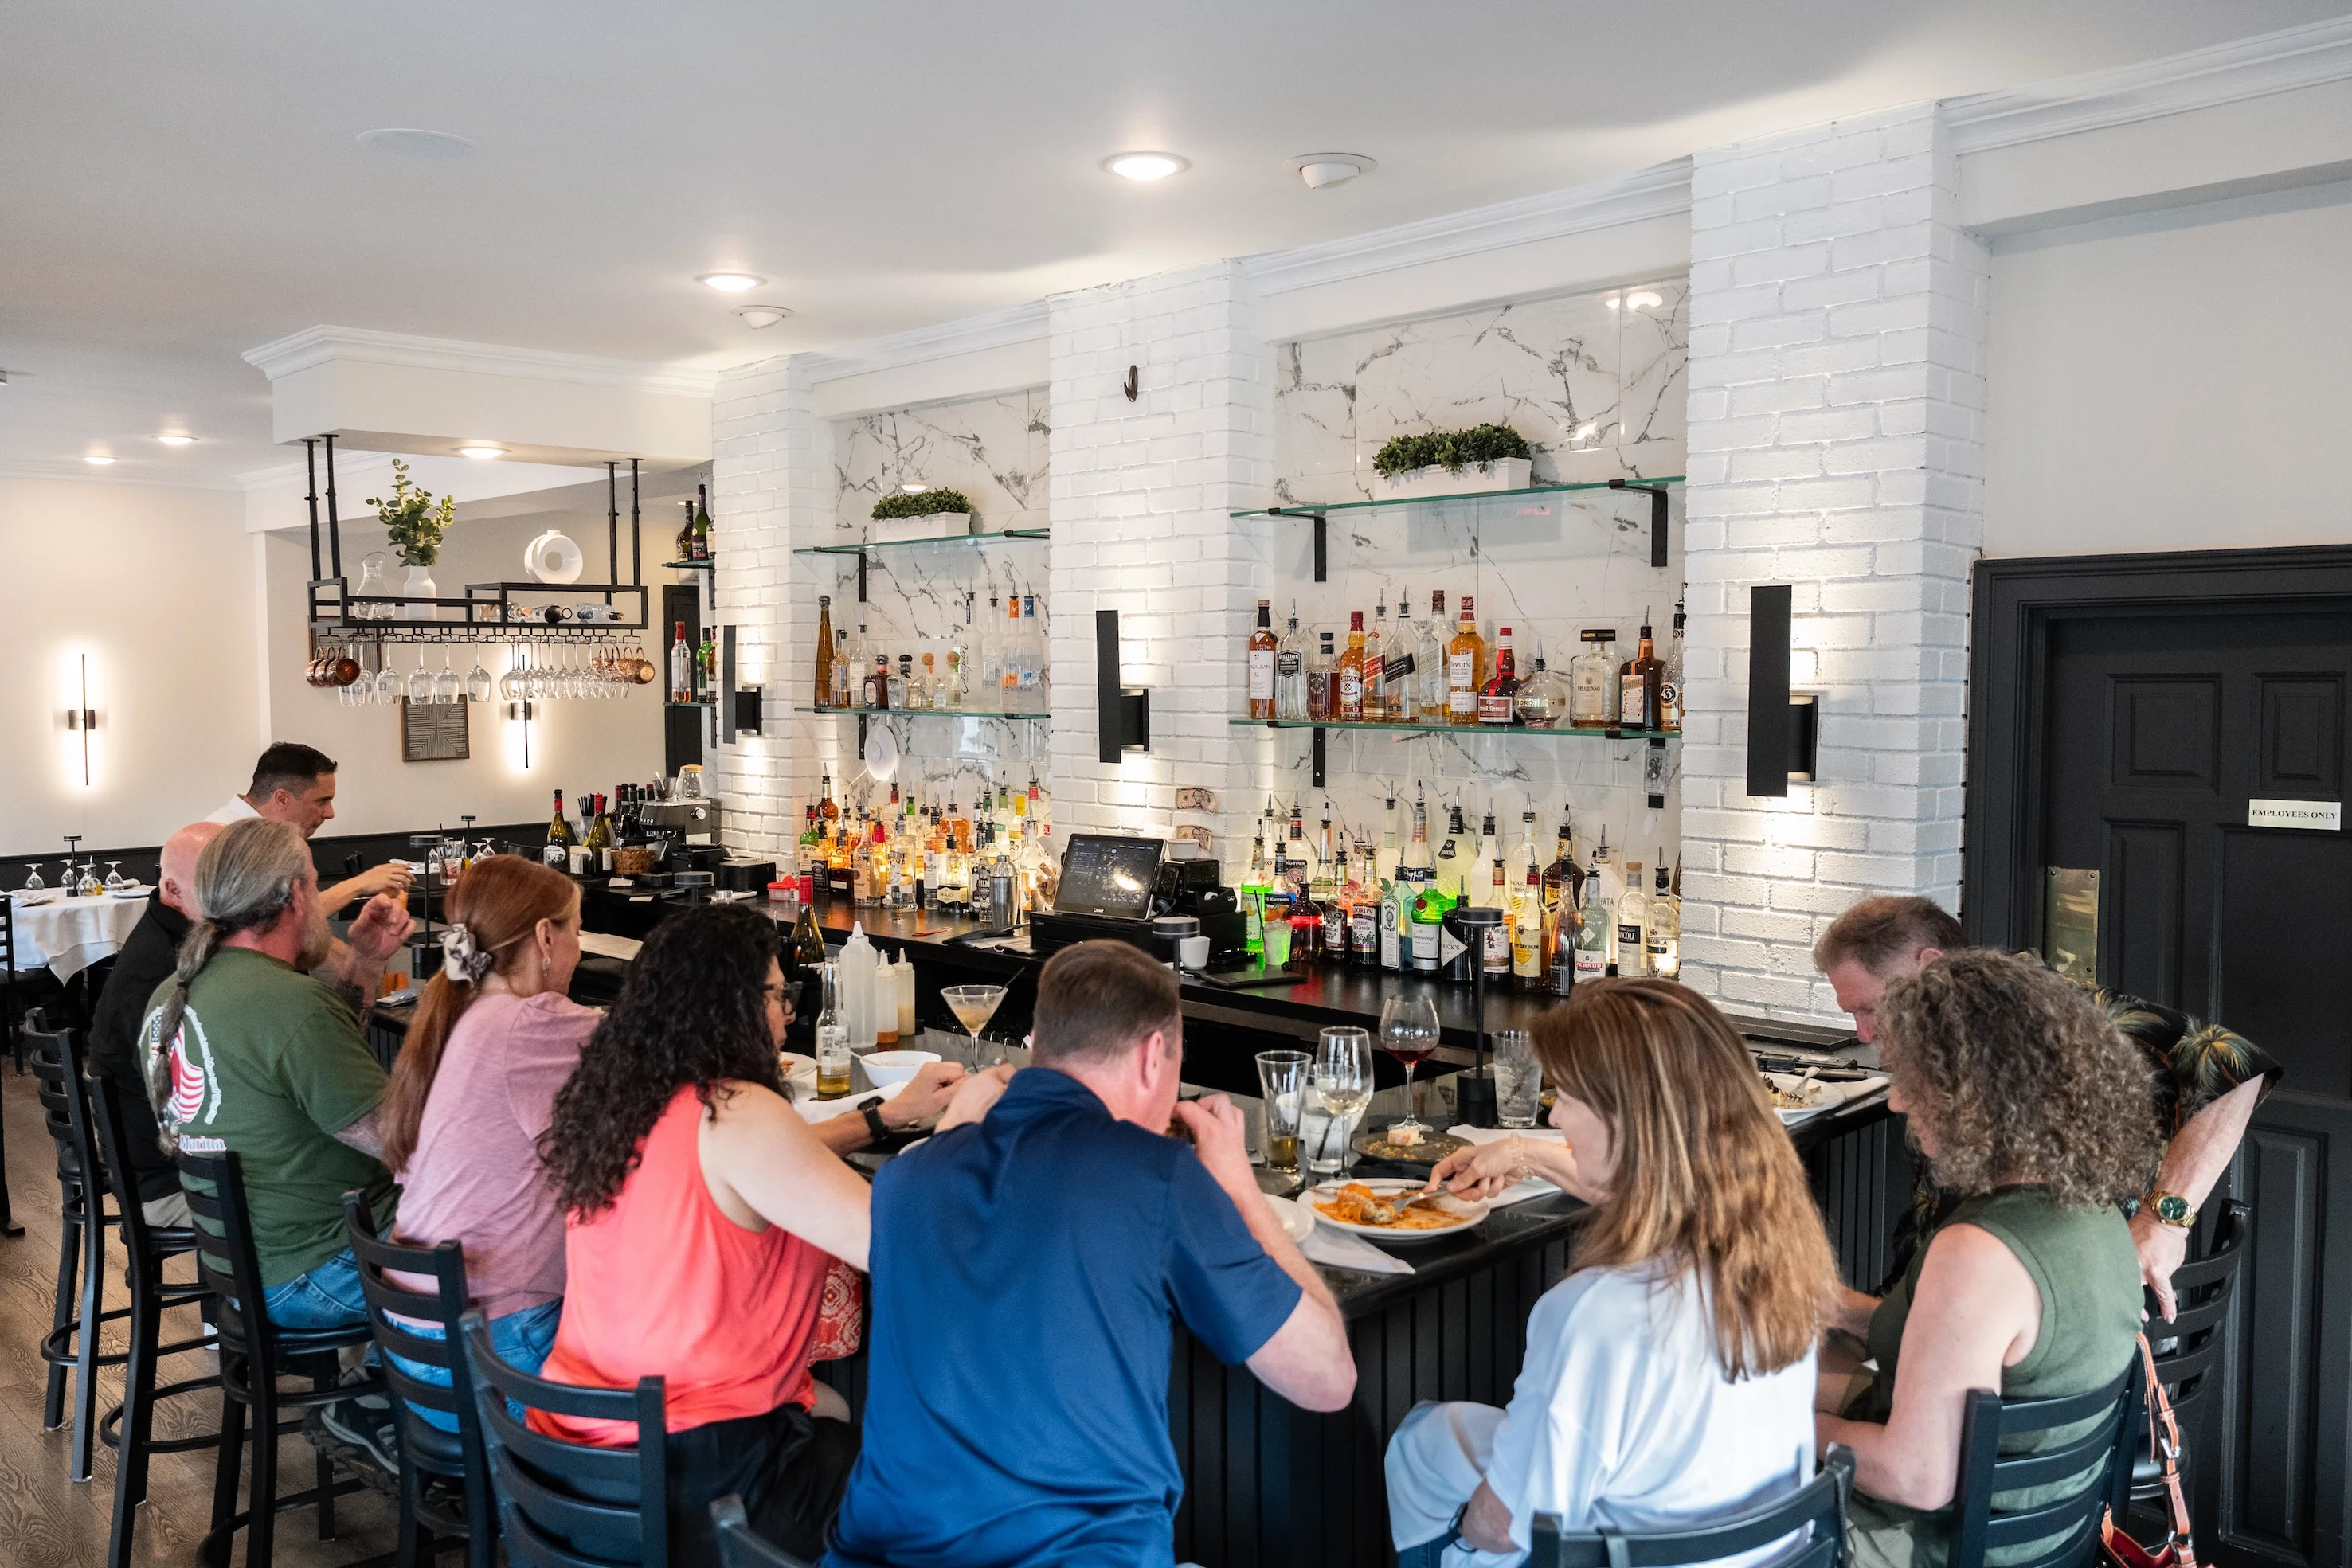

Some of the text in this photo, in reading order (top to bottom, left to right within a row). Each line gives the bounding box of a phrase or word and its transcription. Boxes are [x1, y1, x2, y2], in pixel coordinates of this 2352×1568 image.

[960, 642, 972, 694] Chopin
[1661, 689, 1673, 700] 43
[2252, 809, 2309, 818] EMPLOYEES
[1413, 933, 1434, 941] Tanqueray
[180, 1135, 226, 1152] Marina
